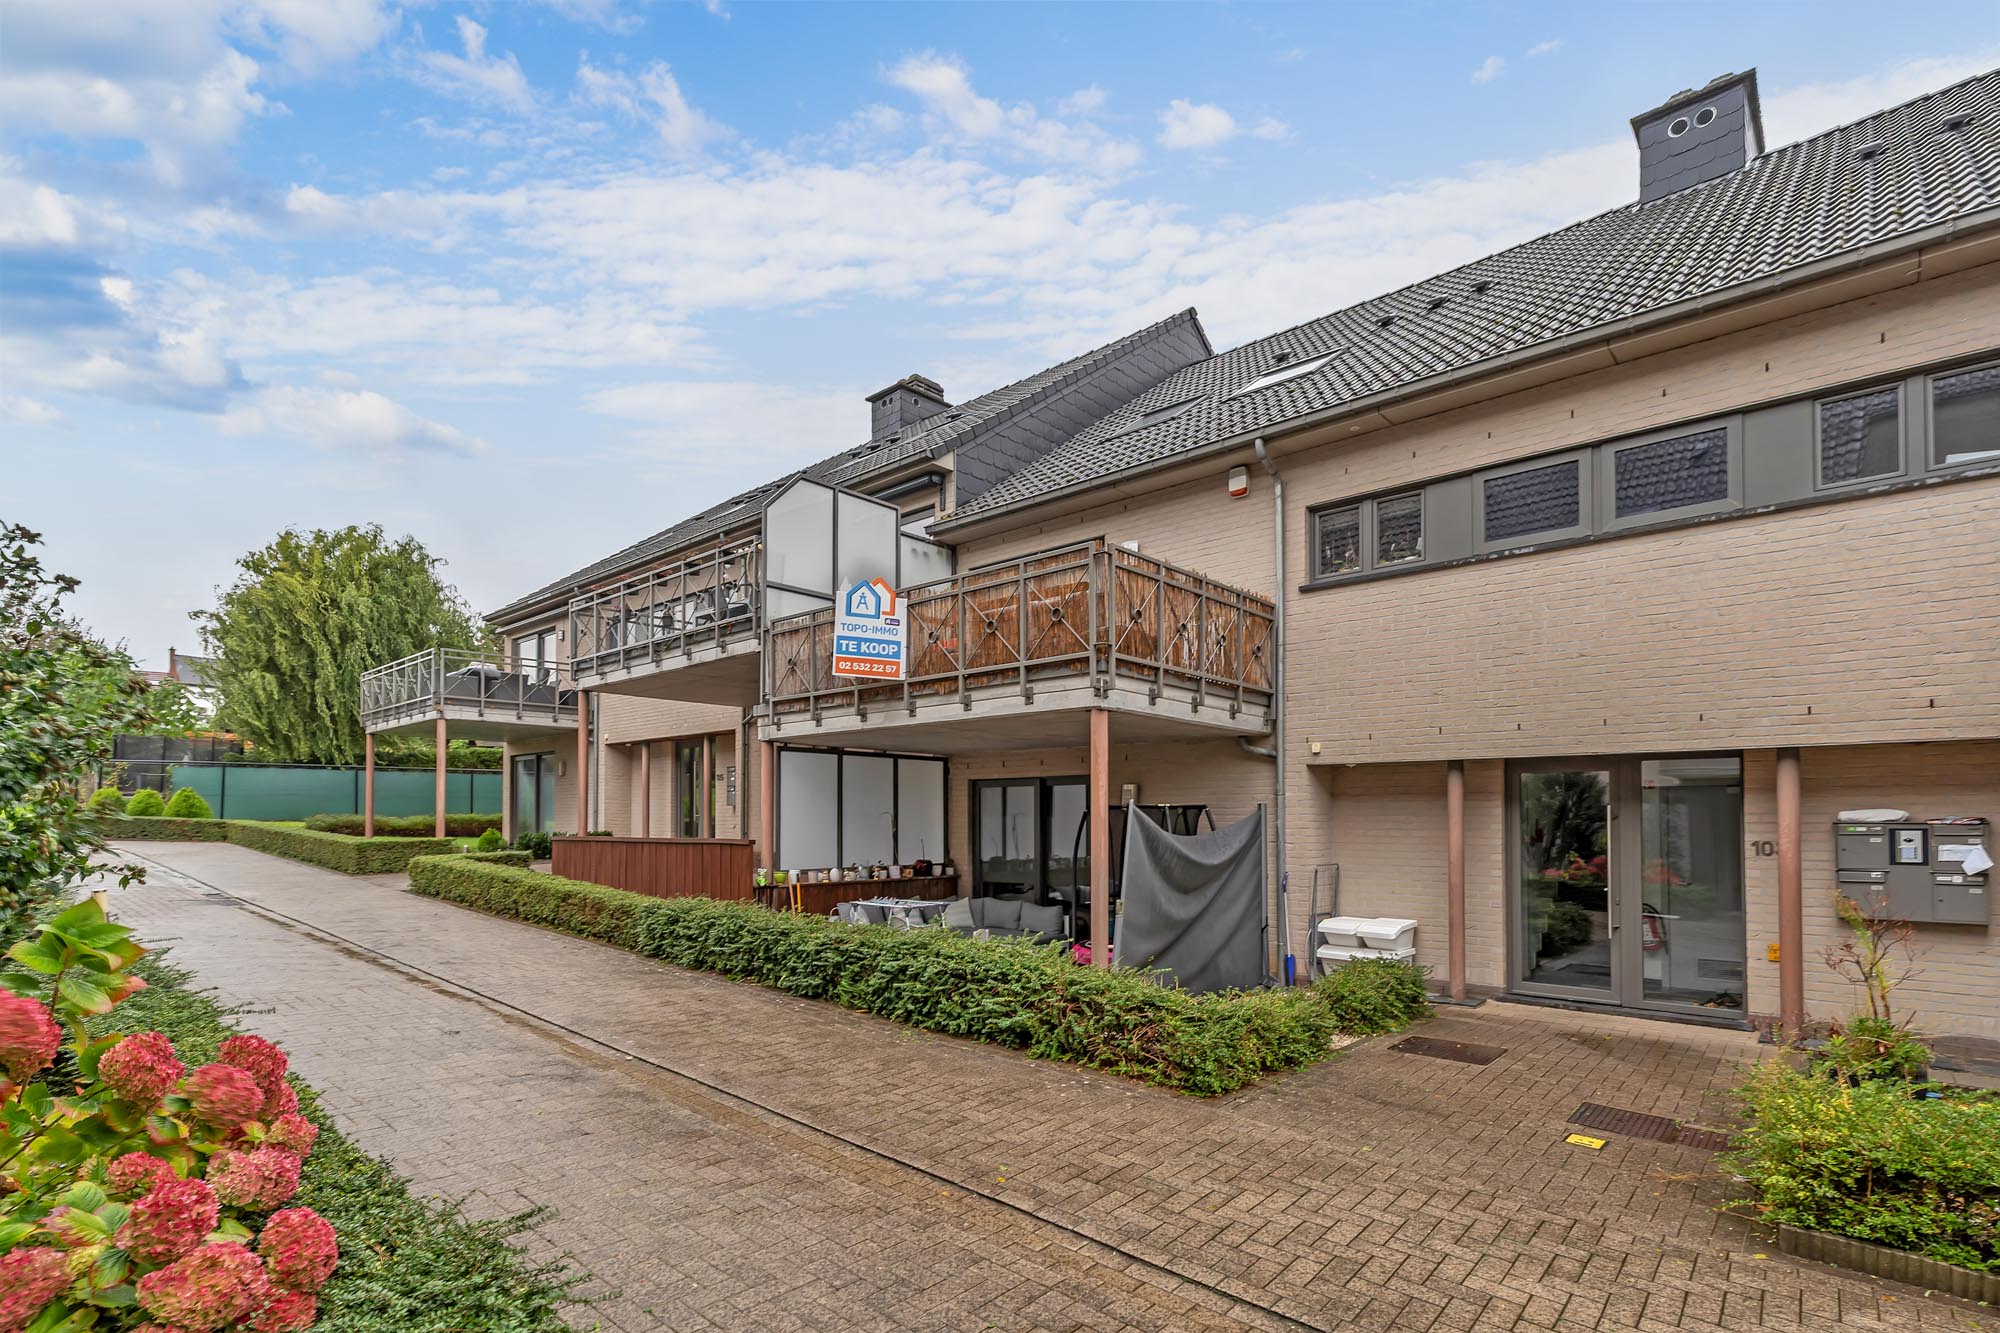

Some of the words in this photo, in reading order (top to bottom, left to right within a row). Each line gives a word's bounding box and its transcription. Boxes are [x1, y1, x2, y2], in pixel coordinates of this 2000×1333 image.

[841, 622, 899, 636] TOPO-IMMO
[840, 640, 858, 652] TE
[861, 642, 898, 655] KOOP
[839, 661, 851, 670] 02
[853, 662, 870, 671] 532
[872, 664, 884, 672] 22
[885, 665, 897, 673] 57
[1751, 840, 1778, 857] 10
